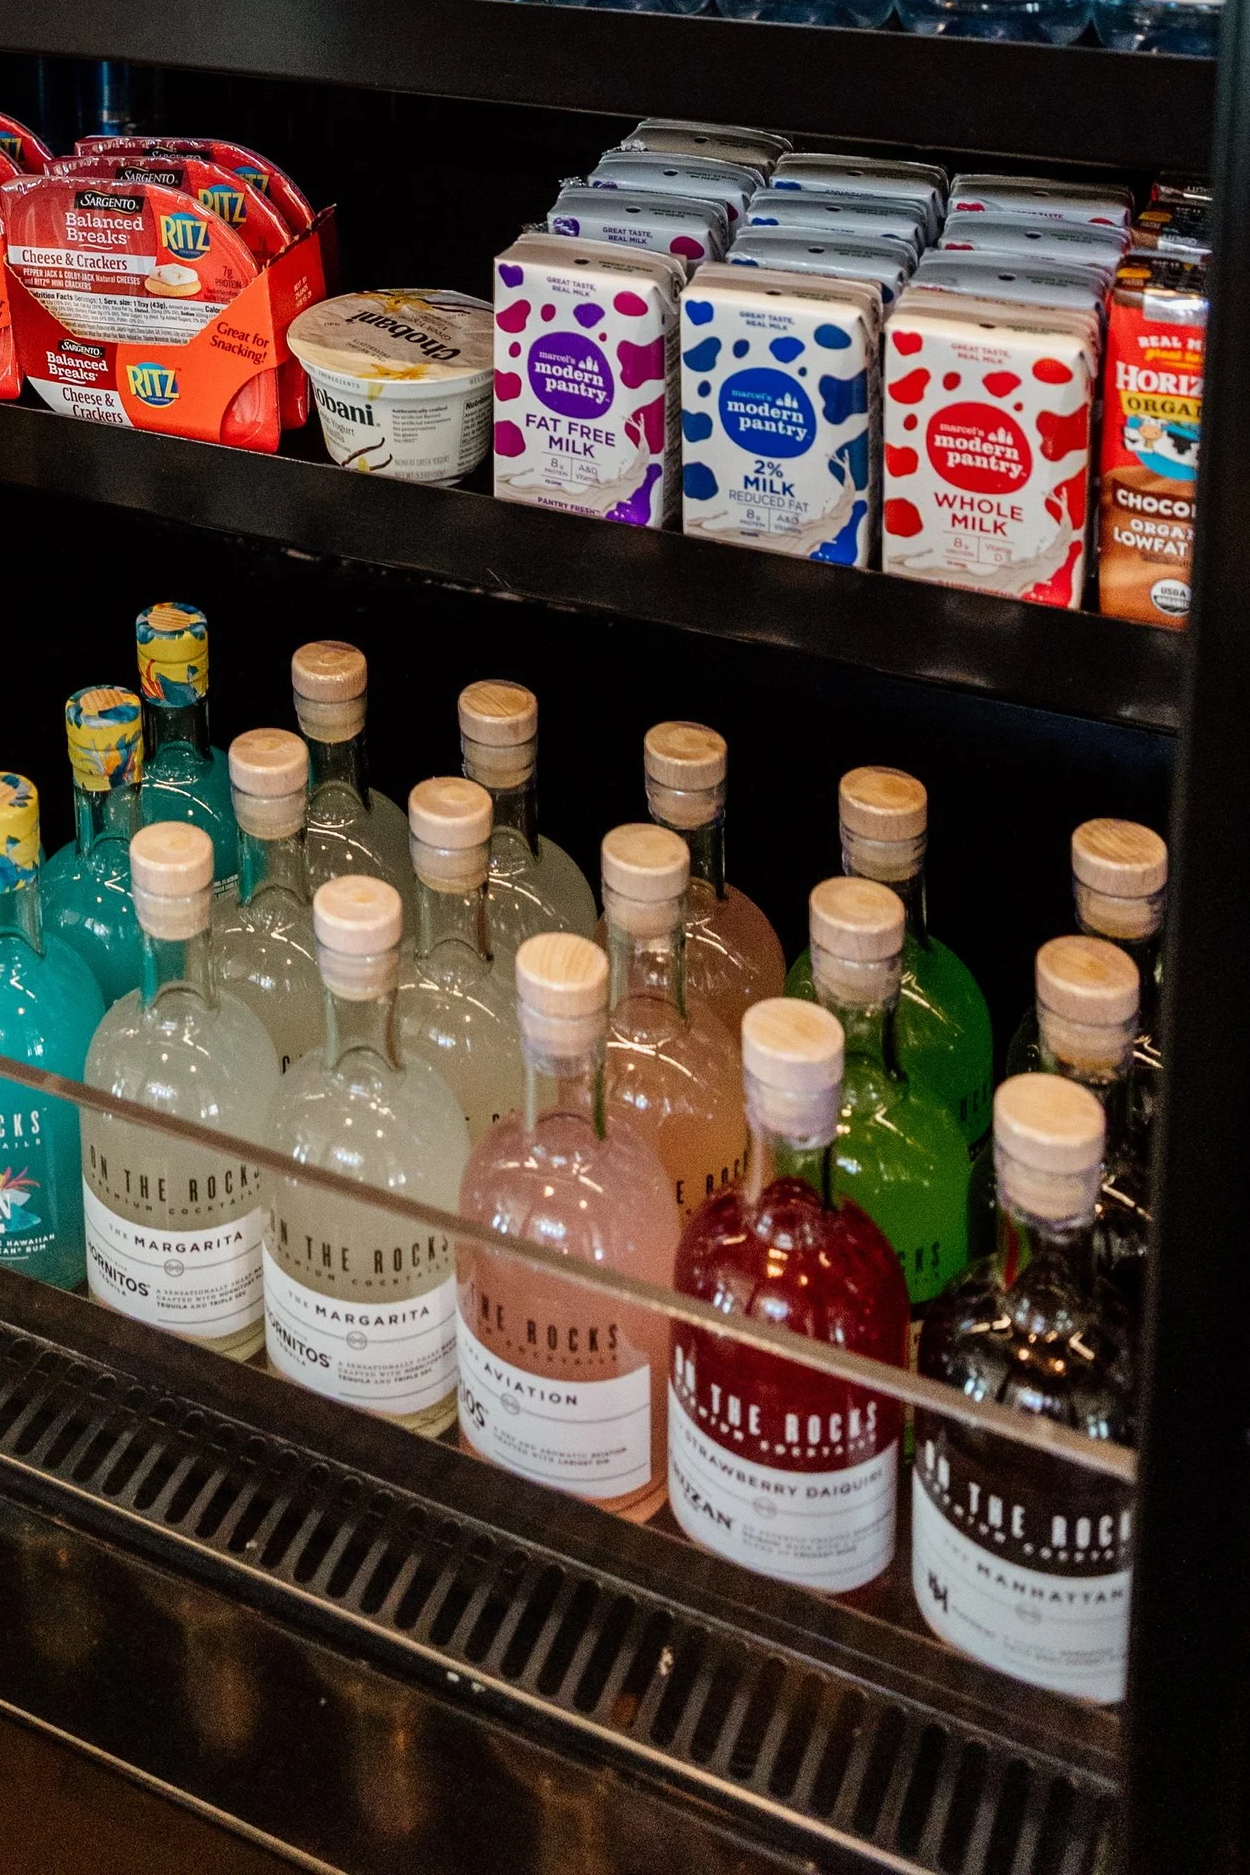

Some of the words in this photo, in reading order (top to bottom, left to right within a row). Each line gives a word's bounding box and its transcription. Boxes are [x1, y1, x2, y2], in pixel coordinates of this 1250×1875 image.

[80, 192, 136, 210] SARGENTO
[65, 212, 144, 232] Balanced
[160, 215, 210, 252] RITZ
[66, 228, 127, 246] Breaks
[22, 249, 64, 266] Cheese
[66, 252, 74, 266] &
[76, 254, 128, 271] Crackers
[216, 321, 251, 343] Great
[251, 332, 270, 348] for
[209, 334, 268, 365] Snacking!
[539, 350, 576, 365] marcel's
[534, 359, 604, 387] modern
[62, 387, 103, 406] Cheese
[104, 392, 114, 407] &
[545, 377, 607, 404] pantry
[72, 404, 123, 424] Crackers
[727, 399, 804, 424] modern
[525, 414, 559, 432] FAT
[568, 422, 616, 447] FREE
[739, 416, 807, 441] pantry
[549, 436, 595, 459] MILK
[934, 434, 1020, 461] modern
[754, 459, 784, 478] 2%
[743, 475, 796, 498] MILK
[729, 489, 785, 510] REDUCED
[788, 499, 809, 512] FAT
[934, 491, 1024, 522] WHOLE
[1113, 527, 1188, 558] LOWFAT
[1160, 586, 1186, 599] USDA
[90, 1144, 108, 1182] ON
[124, 1169, 166, 1202] THE
[6, 1233, 55, 1247] HAWAIIAN
[25, 1242, 47, 1254] RUM
[134, 1230, 243, 1253] MARGARITA
[315, 1304, 430, 1327] MARGARITA
[483, 1363, 579, 1408] AVIATION
[711, 1382, 761, 1436] THE
[785, 1400, 877, 1445] ROCKS
[976, 1561, 1124, 1606] MANHATTAN
